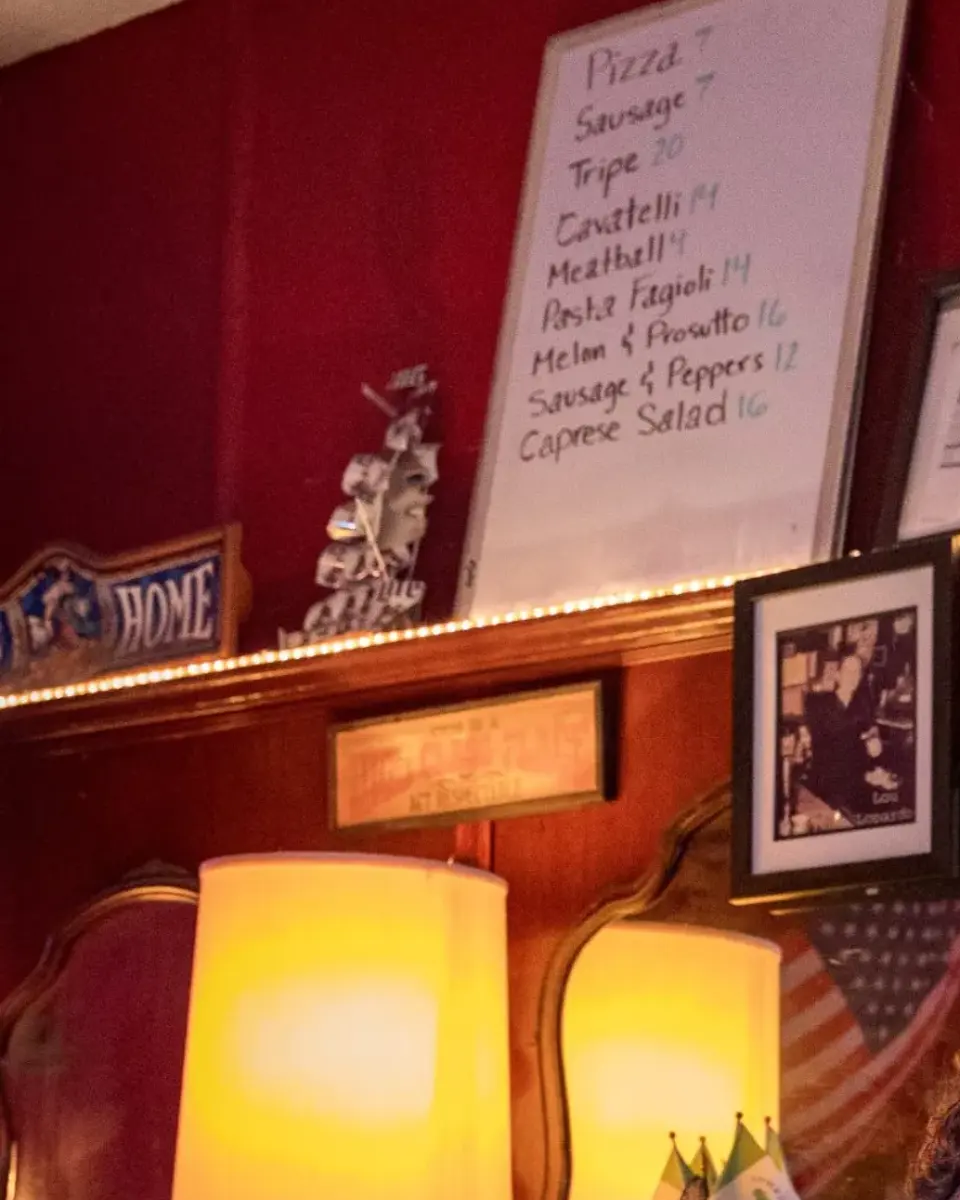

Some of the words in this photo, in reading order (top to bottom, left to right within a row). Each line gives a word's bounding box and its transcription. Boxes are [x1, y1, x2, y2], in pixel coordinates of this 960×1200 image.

[587, 41, 683, 91] Pizza
[574, 90, 686, 142] Sausage
[568, 150, 639, 198] Tripe
[650, 134, 685, 165] 20
[556, 192, 681, 247] Cavatelli
[689, 182, 720, 214] 14
[541, 295, 615, 333] Pasta
[630, 264, 715, 318] Fagioli
[721, 253, 752, 286] 14
[547, 233, 665, 289] Meatball
[531, 339, 606, 376] Melon
[646, 308, 750, 349] Prosutto
[756, 298, 787, 330] 16
[529, 375, 630, 418] Sausage
[667, 350, 765, 392] Peppers
[774, 341, 799, 372] 12
[519, 418, 620, 465] Caprese
[637, 390, 728, 437] Salad
[737, 391, 768, 421] 16
[116, 561, 215, 654] HOME
